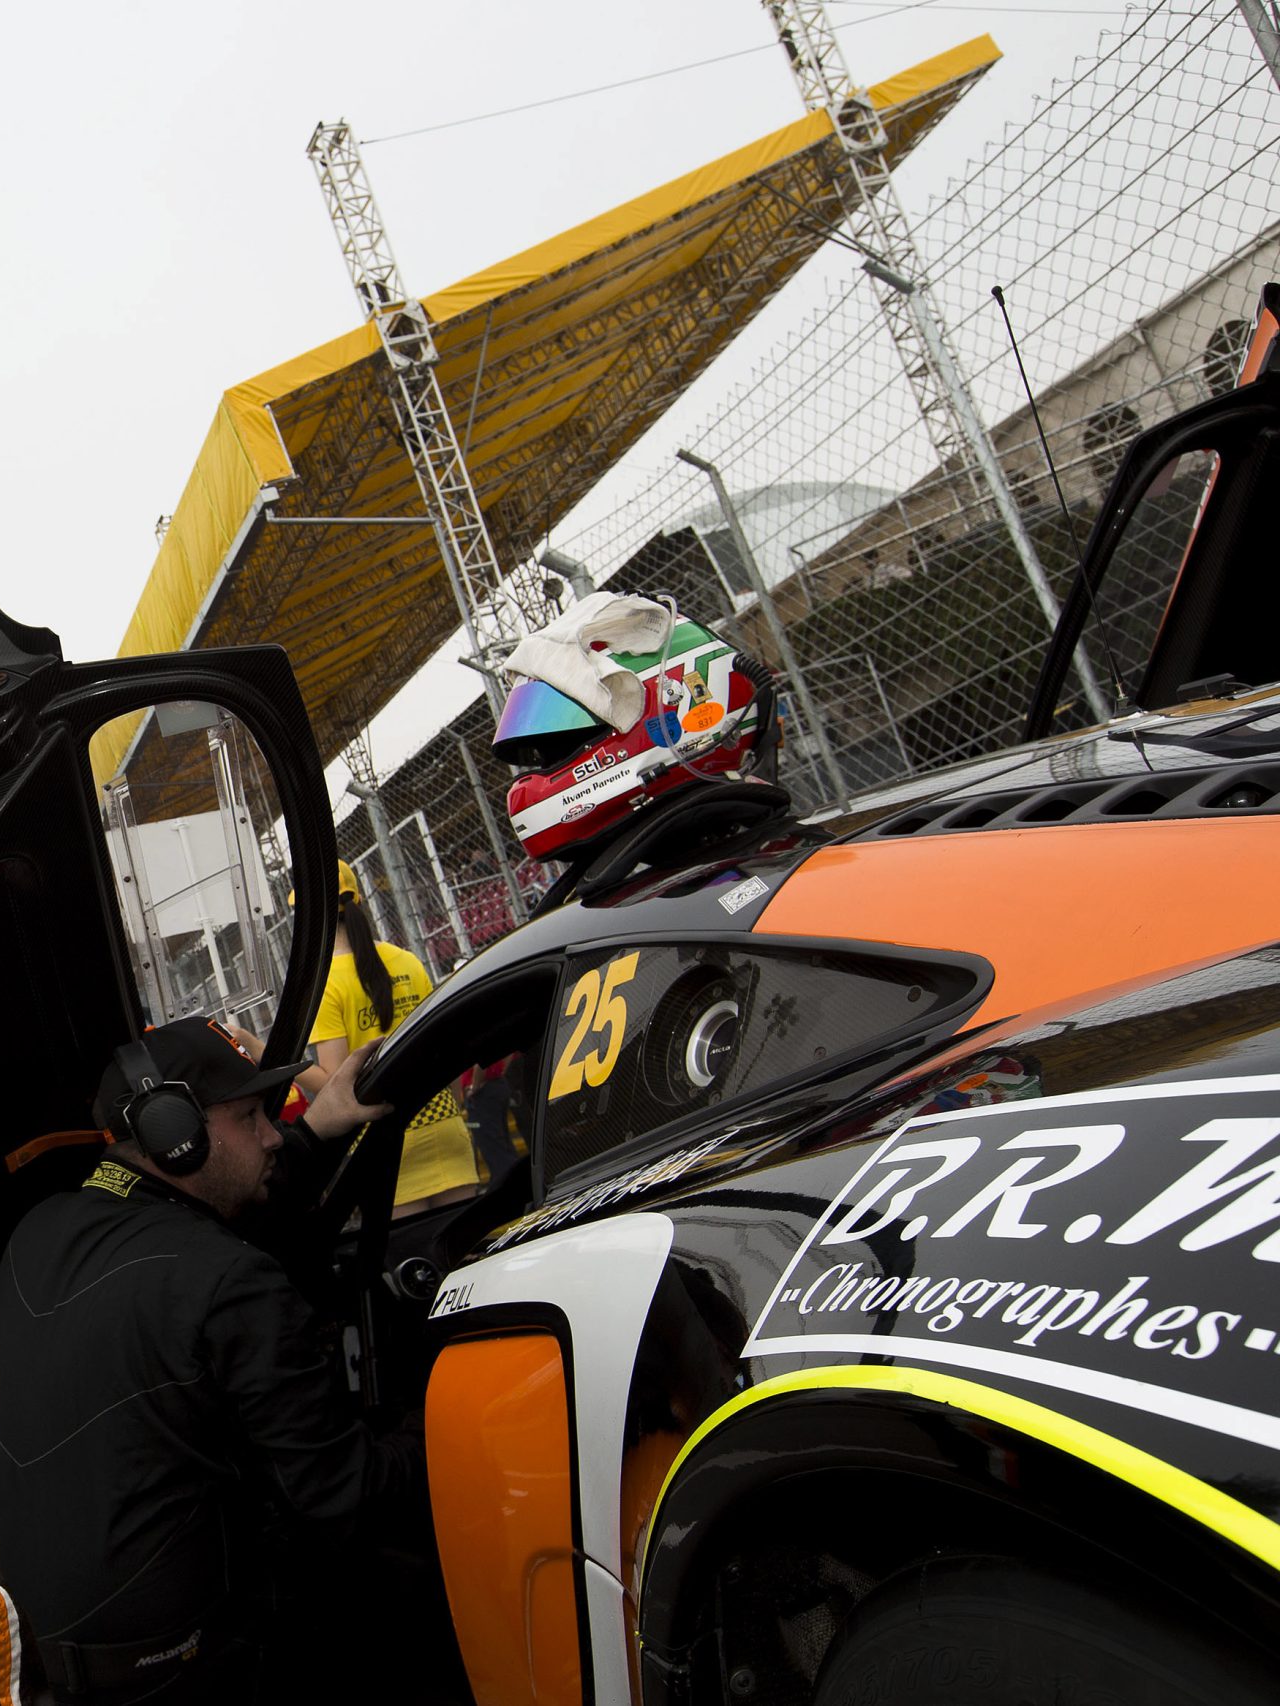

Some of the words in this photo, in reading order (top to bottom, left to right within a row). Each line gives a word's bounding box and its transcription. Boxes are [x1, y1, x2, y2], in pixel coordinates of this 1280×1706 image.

[574, 748, 614, 779] Stilo
[547, 951, 640, 1101] 25
[441, 1282, 475, 1315] PULL
[798, 1263, 1242, 1360] Chronographes
